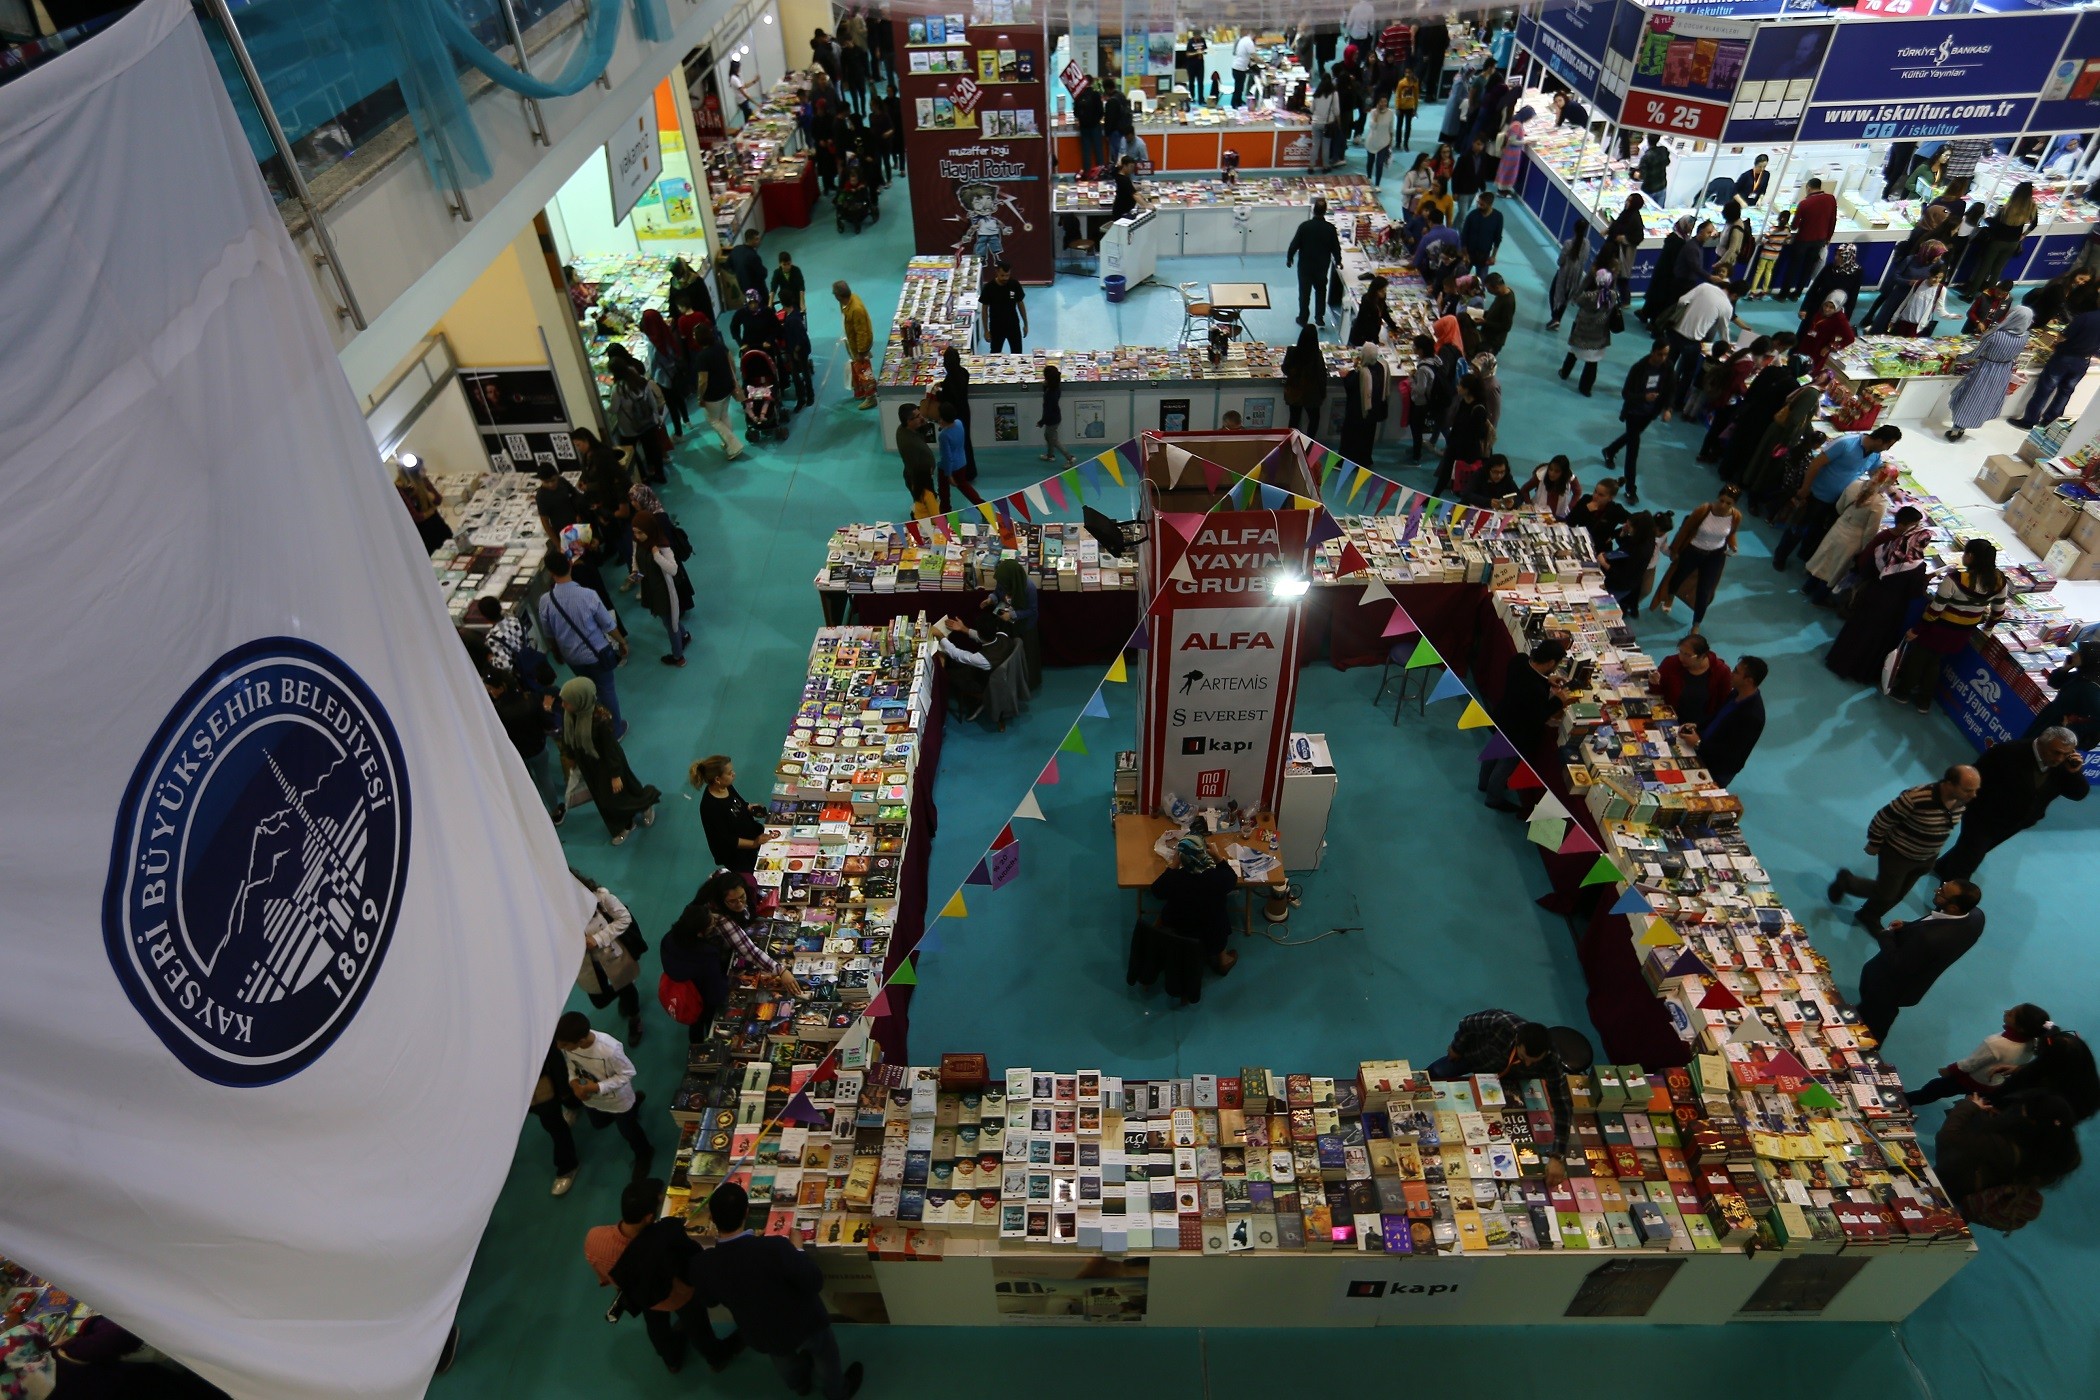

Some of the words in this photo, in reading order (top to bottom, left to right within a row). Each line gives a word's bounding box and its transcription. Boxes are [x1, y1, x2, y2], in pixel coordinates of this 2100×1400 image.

[1897, 47, 1937, 58] TÜRKİYE
[1950, 44, 1992, 56] BANKASI
[1900, 68, 1930, 79] Kültür
[1930, 69, 1966, 79] Yayınları
[1646, 100, 1667, 125] %
[1670, 104, 1702, 131] 25
[1824, 101, 2016, 124] www.iskultur.com.tr
[1908, 123, 1960, 137] iskultur
[939, 158, 980, 183] Hayri
[983, 159, 1025, 177] Potur
[1197, 528, 1279, 547] ALFA
[1191, 553, 1286, 570] YAYIN
[1180, 631, 1275, 651] ALFA
[1200, 673, 1268, 691] ARTEMİS
[1193, 709, 1269, 723] EVEREST
[1962, 710, 1984, 737] Hayat
[280, 677, 393, 812] BELEDİYESİ
[1209, 737, 1253, 753] kapı
[140, 678, 274, 912] BÜYÜKŞEHİR
[323, 897, 380, 999] 1869
[136, 934, 254, 1044] KAYSERİ
[1389, 1281, 1459, 1296] kapı
